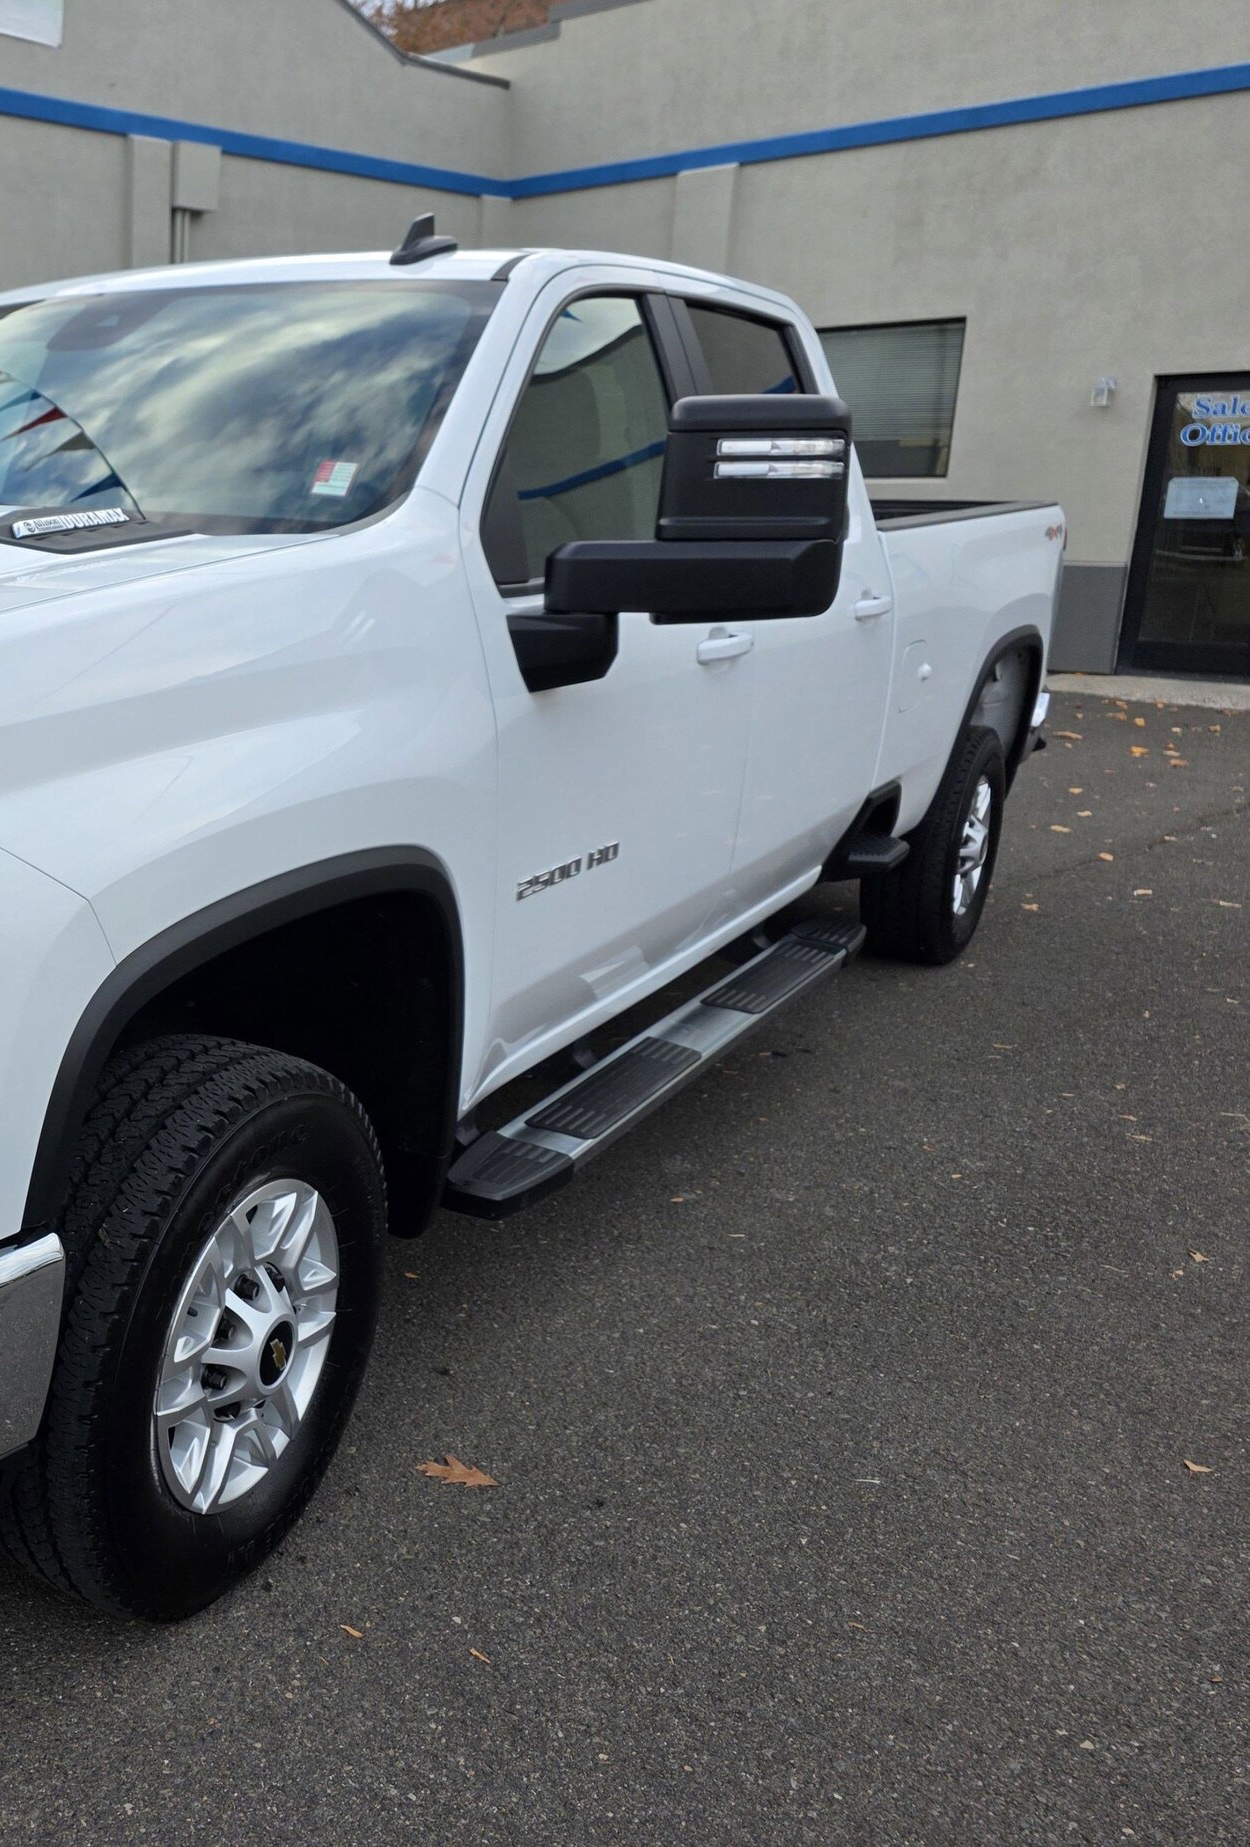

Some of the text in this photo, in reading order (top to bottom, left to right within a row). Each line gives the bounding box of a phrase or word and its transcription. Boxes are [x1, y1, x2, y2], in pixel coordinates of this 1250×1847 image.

[63, 507, 130, 530] DURAMAX
[515, 840, 620, 902] 2500 HD
